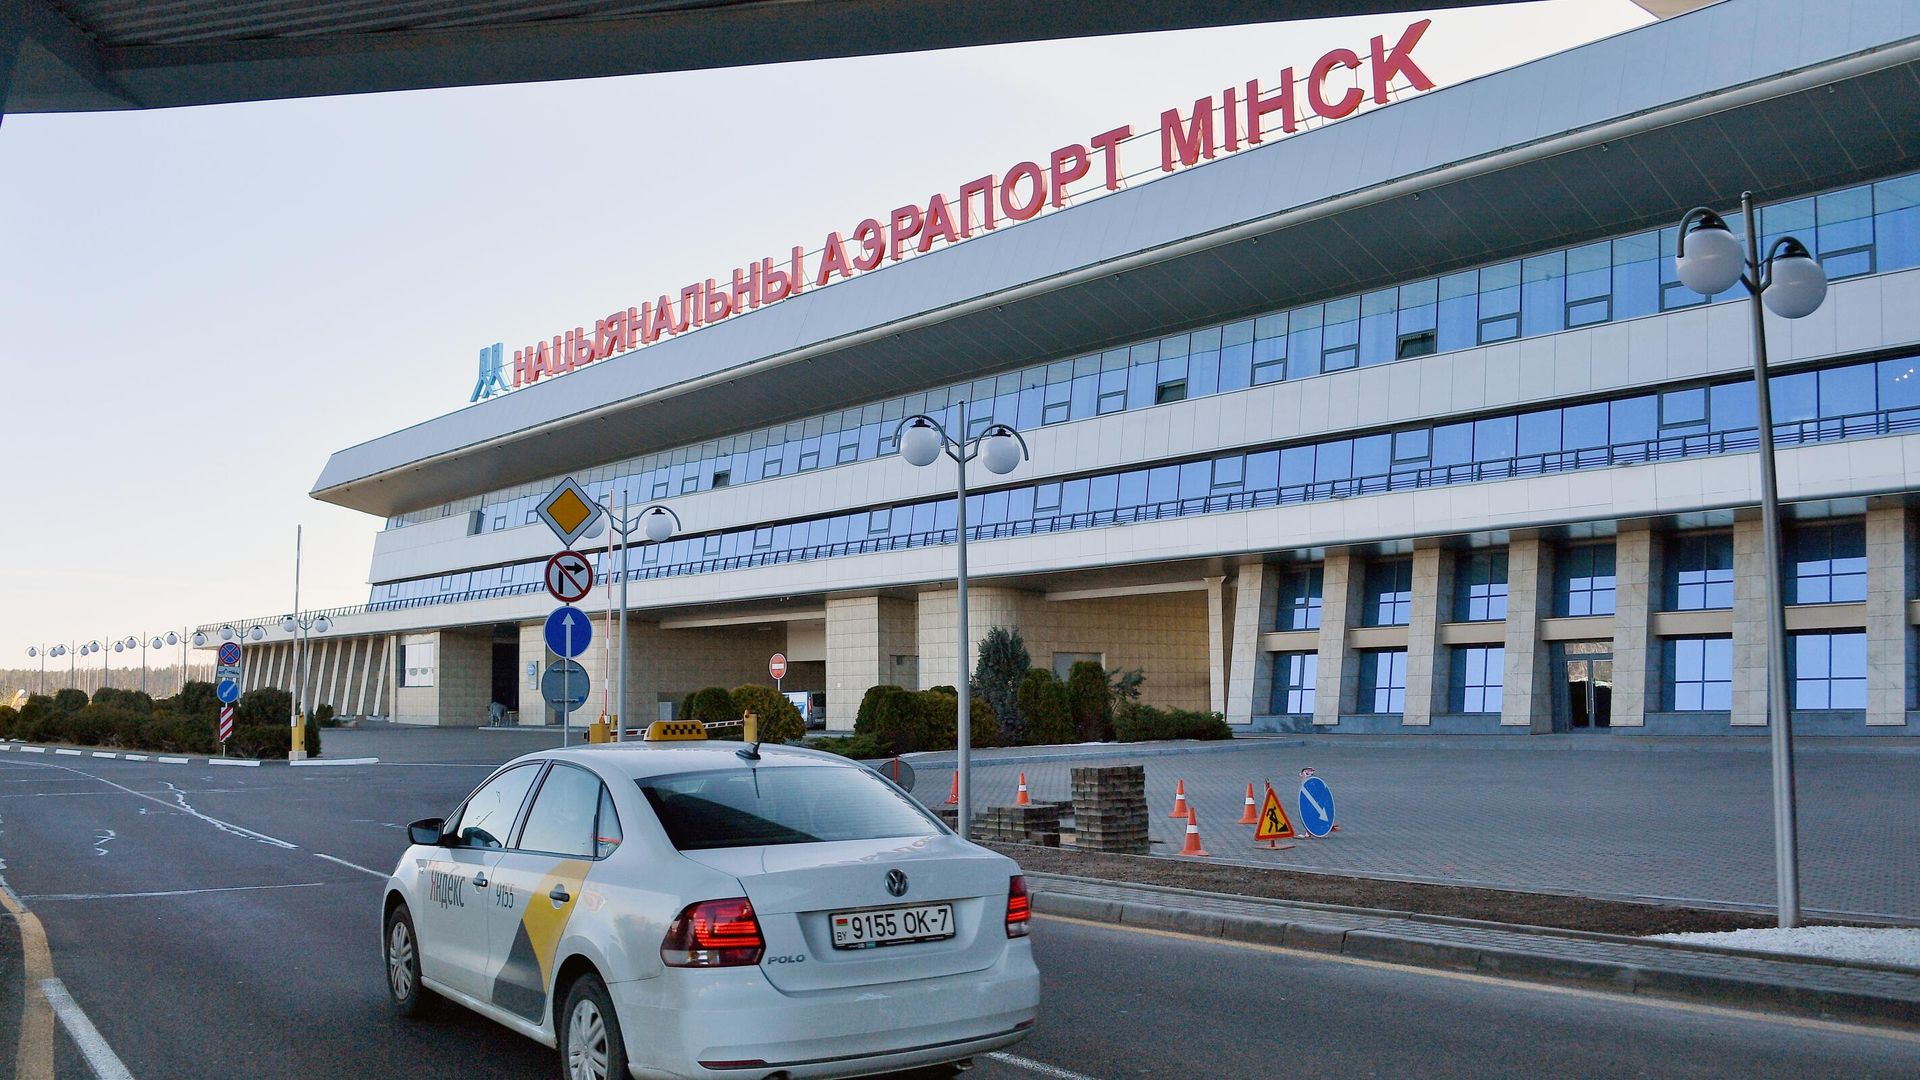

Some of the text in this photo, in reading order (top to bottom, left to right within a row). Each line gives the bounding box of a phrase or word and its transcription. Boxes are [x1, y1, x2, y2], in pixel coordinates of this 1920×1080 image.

[513, 19, 1436, 388] НАЦЫЯНАЛЬНЫ АЭРАПОРТ МІНСК
[430, 869, 466, 909] Яндекс
[496, 883, 514, 909] 9155
[836, 931, 847, 941] BY
[852, 908, 948, 939] 9155 OK-7
[767, 954, 806, 965] POLO
